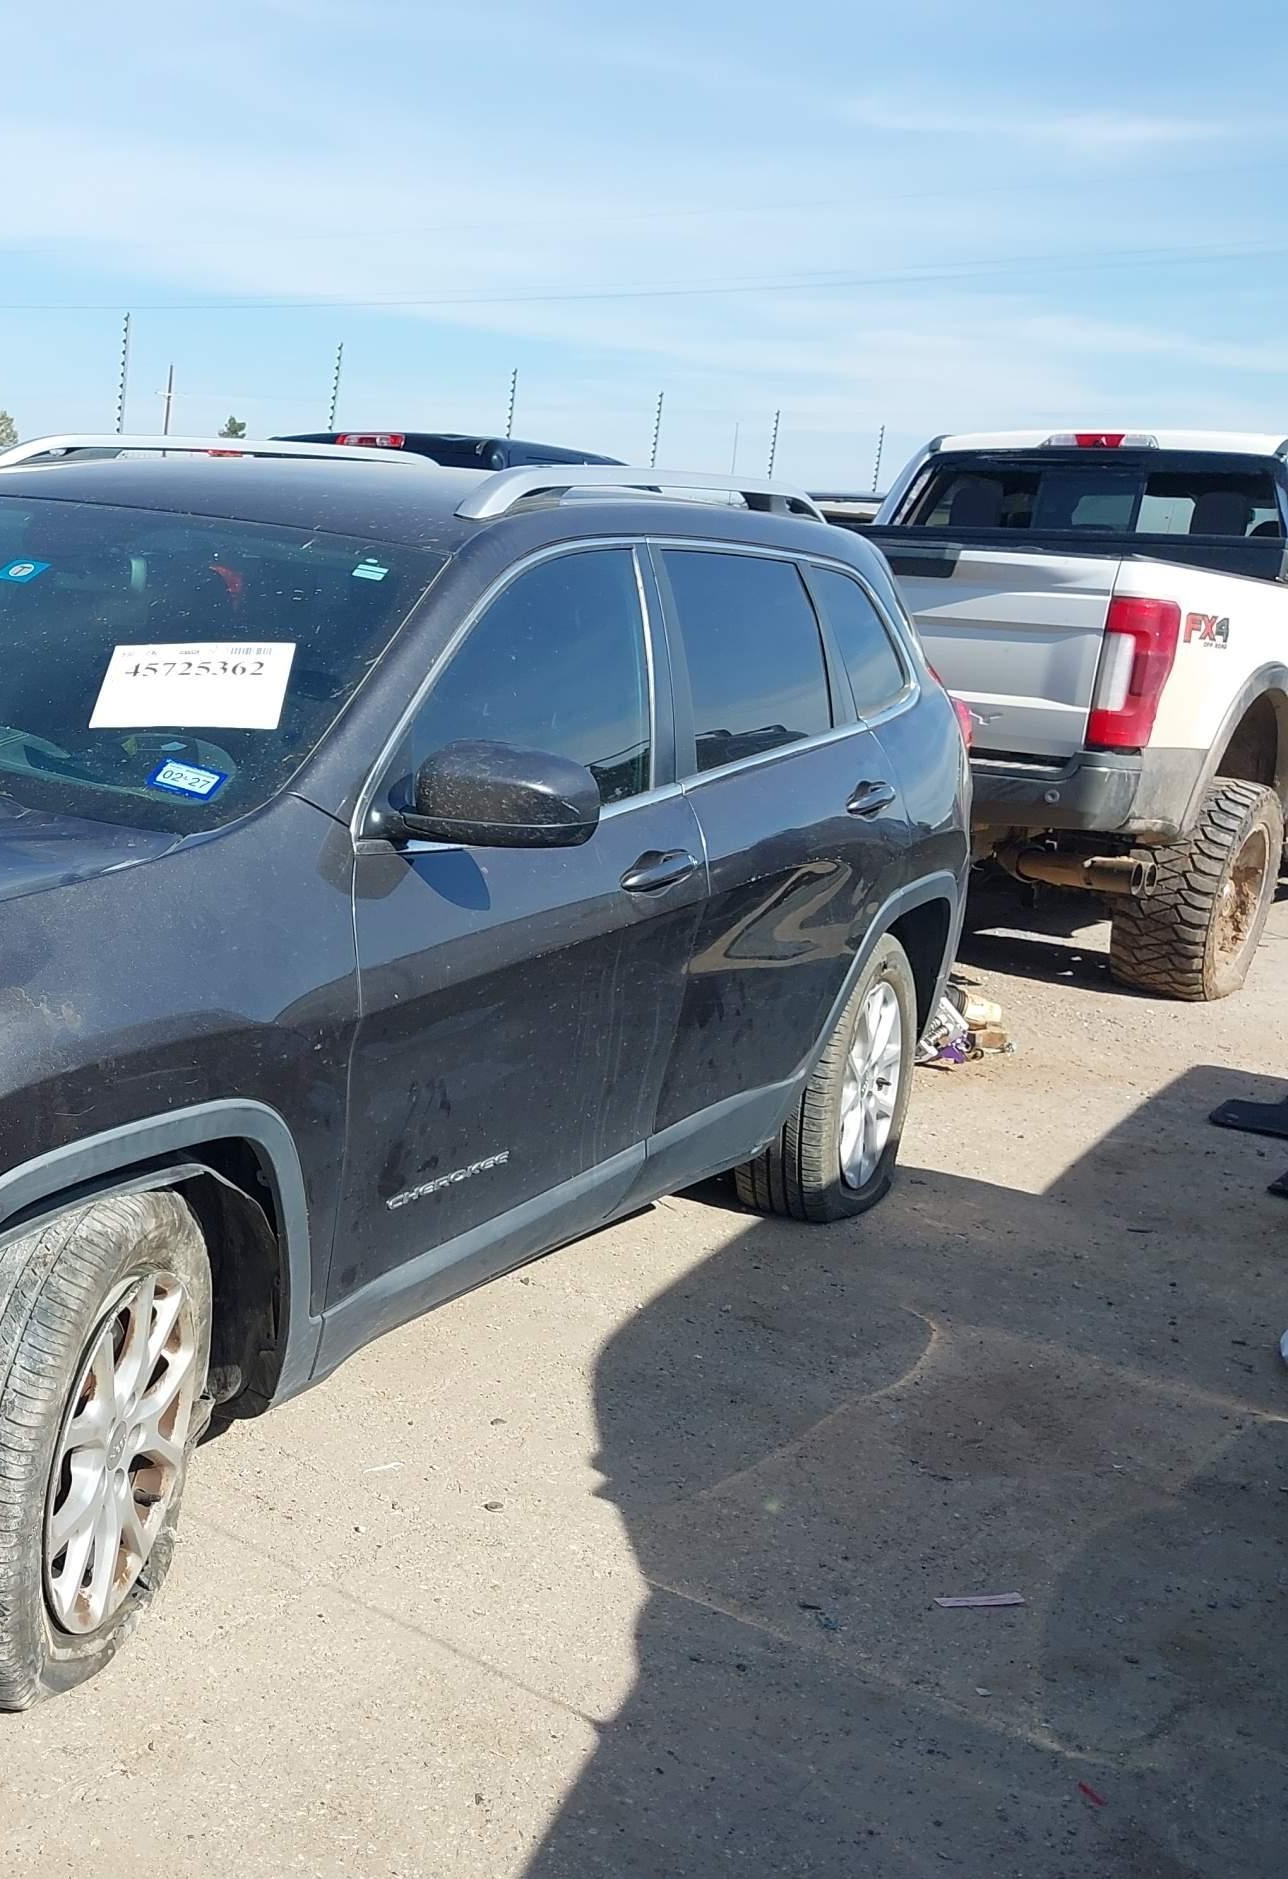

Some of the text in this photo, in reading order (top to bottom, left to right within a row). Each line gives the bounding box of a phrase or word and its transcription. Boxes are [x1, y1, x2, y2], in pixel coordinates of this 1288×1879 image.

[1183, 612, 1229, 643] FX4
[124, 660, 265, 678] 45725362
[385, 1150, 510, 1210] CHEROKEE
